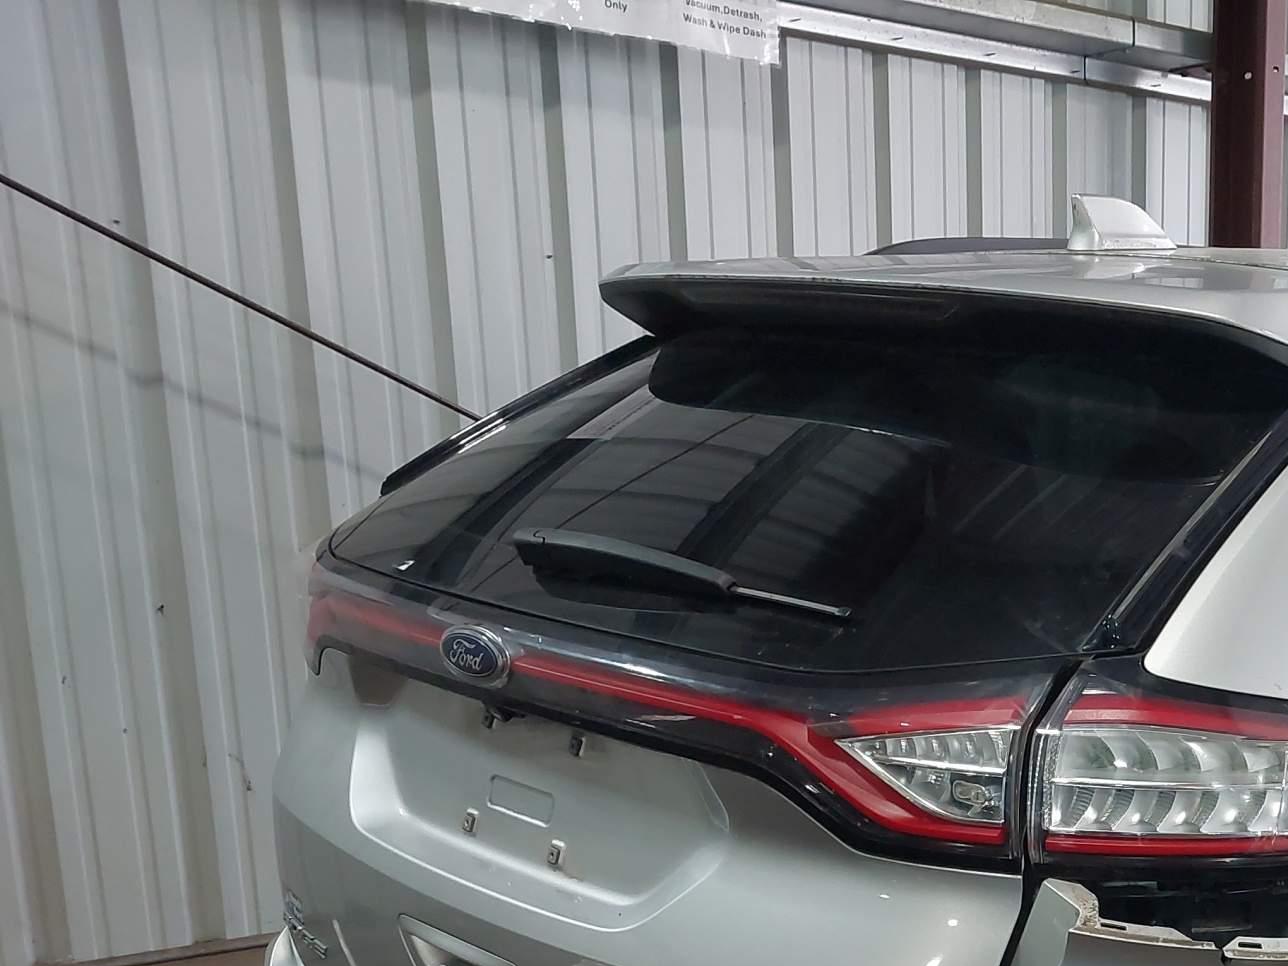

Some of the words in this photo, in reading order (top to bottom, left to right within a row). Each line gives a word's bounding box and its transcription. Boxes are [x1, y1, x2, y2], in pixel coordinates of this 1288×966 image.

[604, 0, 628, 13] Only
[682, 12, 708, 27] Wash
[709, 18, 716, 29] &
[717, 20, 741, 34] Wipe
[742, 26, 767, 39] Dash
[449, 638, 484, 671] Ford
